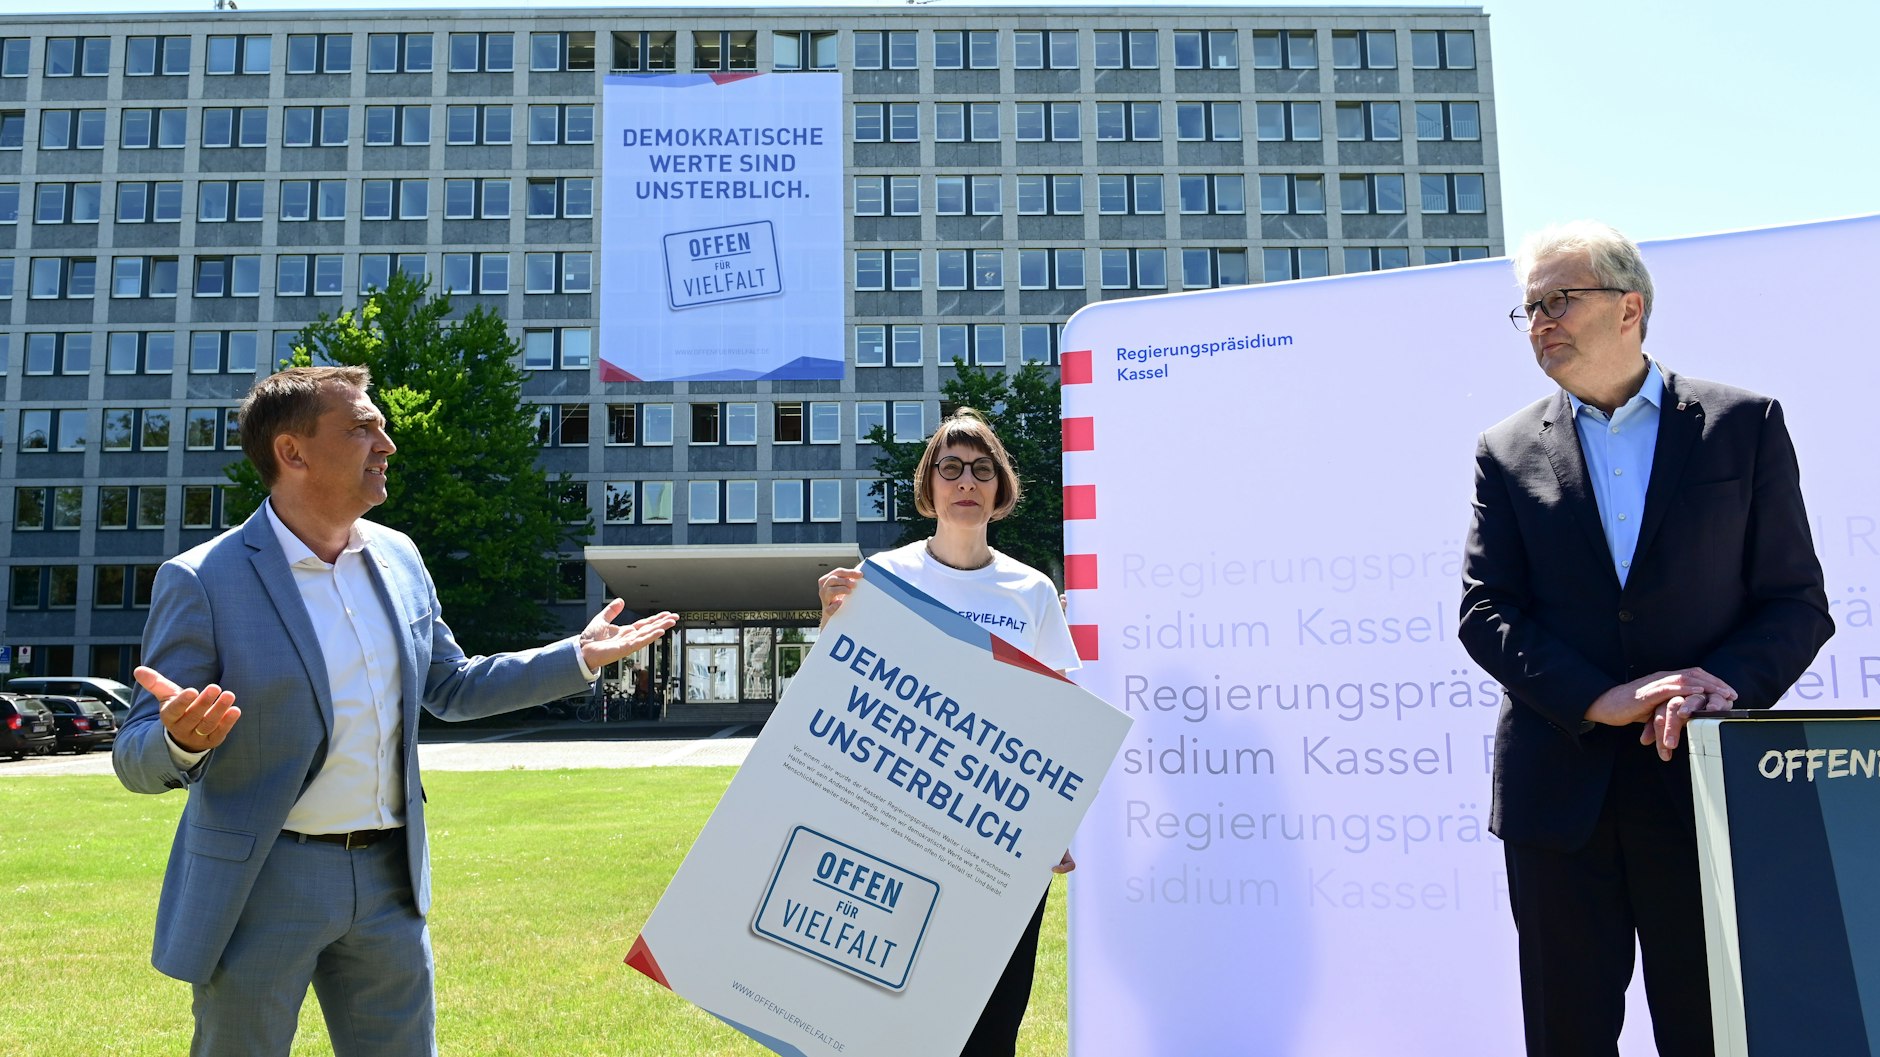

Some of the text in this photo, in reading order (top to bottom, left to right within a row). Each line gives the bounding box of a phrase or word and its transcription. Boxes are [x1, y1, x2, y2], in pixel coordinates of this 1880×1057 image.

[623, 128, 824, 146] DEMOKRATISCHE
[649, 154, 796, 173] WERTE SIND
[636, 180, 810, 200] UNSTERBLICH.
[689, 232, 751, 258] OFFEN
[714, 260, 730, 270] FÜR
[684, 268, 765, 297] VIELFALT
[1117, 334, 1293, 362] Regierungspräsidium
[1118, 364, 1168, 382] Kassel
[1123, 539, 1462, 598] Regierungsprä
[798, 610, 822, 620] KASS
[958, 611, 1027, 634] ERVIELFALT
[1122, 601, 1444, 650] sidium Kassel
[829, 634, 1083, 802] DEMOKRATISCHE
[1125, 669, 1500, 723] Regierungspräs
[847, 685, 1029, 811] WERTE SIND
[1124, 734, 1274, 774] sidium
[1303, 732, 1452, 775] Kassel
[1758, 749, 1880, 782] OFFEN
[793, 744, 803, 753] Vor
[803, 752, 820, 764] einem
[820, 760, 834, 772] Jahr
[834, 769, 852, 783] wurde
[852, 780, 862, 789] der
[862, 786, 887, 804] Kasseler
[942, 833, 960, 848] Walter
[810, 709, 1022, 858] UNSTERBLICH.
[782, 761, 823, 789] Menschlichkeit
[822, 785, 840, 799] weiter
[860, 808, 880, 824] Zeigen
[890, 826, 904, 838] dass
[903, 834, 924, 850] Hessen
[923, 844, 938, 858] offen
[946, 859, 966, 875] Vielfalt
[974, 876, 987, 887] Und
[787, 752, 806, 768] Halten
[816, 771, 828, 781] sein
[827, 778, 855, 797] Andenken
[880, 808, 898, 822] indem
[898, 819, 908, 827] wir
[907, 825, 946, 852] demokratische
[947, 847, 963, 863] Werte
[963, 859, 974, 868] wie
[974, 864, 997, 882] Toleranz
[996, 879, 1009, 888] und
[1127, 800, 1502, 854] Regierungsprä
[817, 852, 903, 908] OFFEN
[1126, 863, 1278, 906] sidium
[1308, 868, 1460, 911] Kassel
[836, 898, 858, 920] FÜR
[784, 899, 898, 968] VIELFALT
[732, 980, 846, 1052] WWW.OFFENFUERVIELFALT.DE
